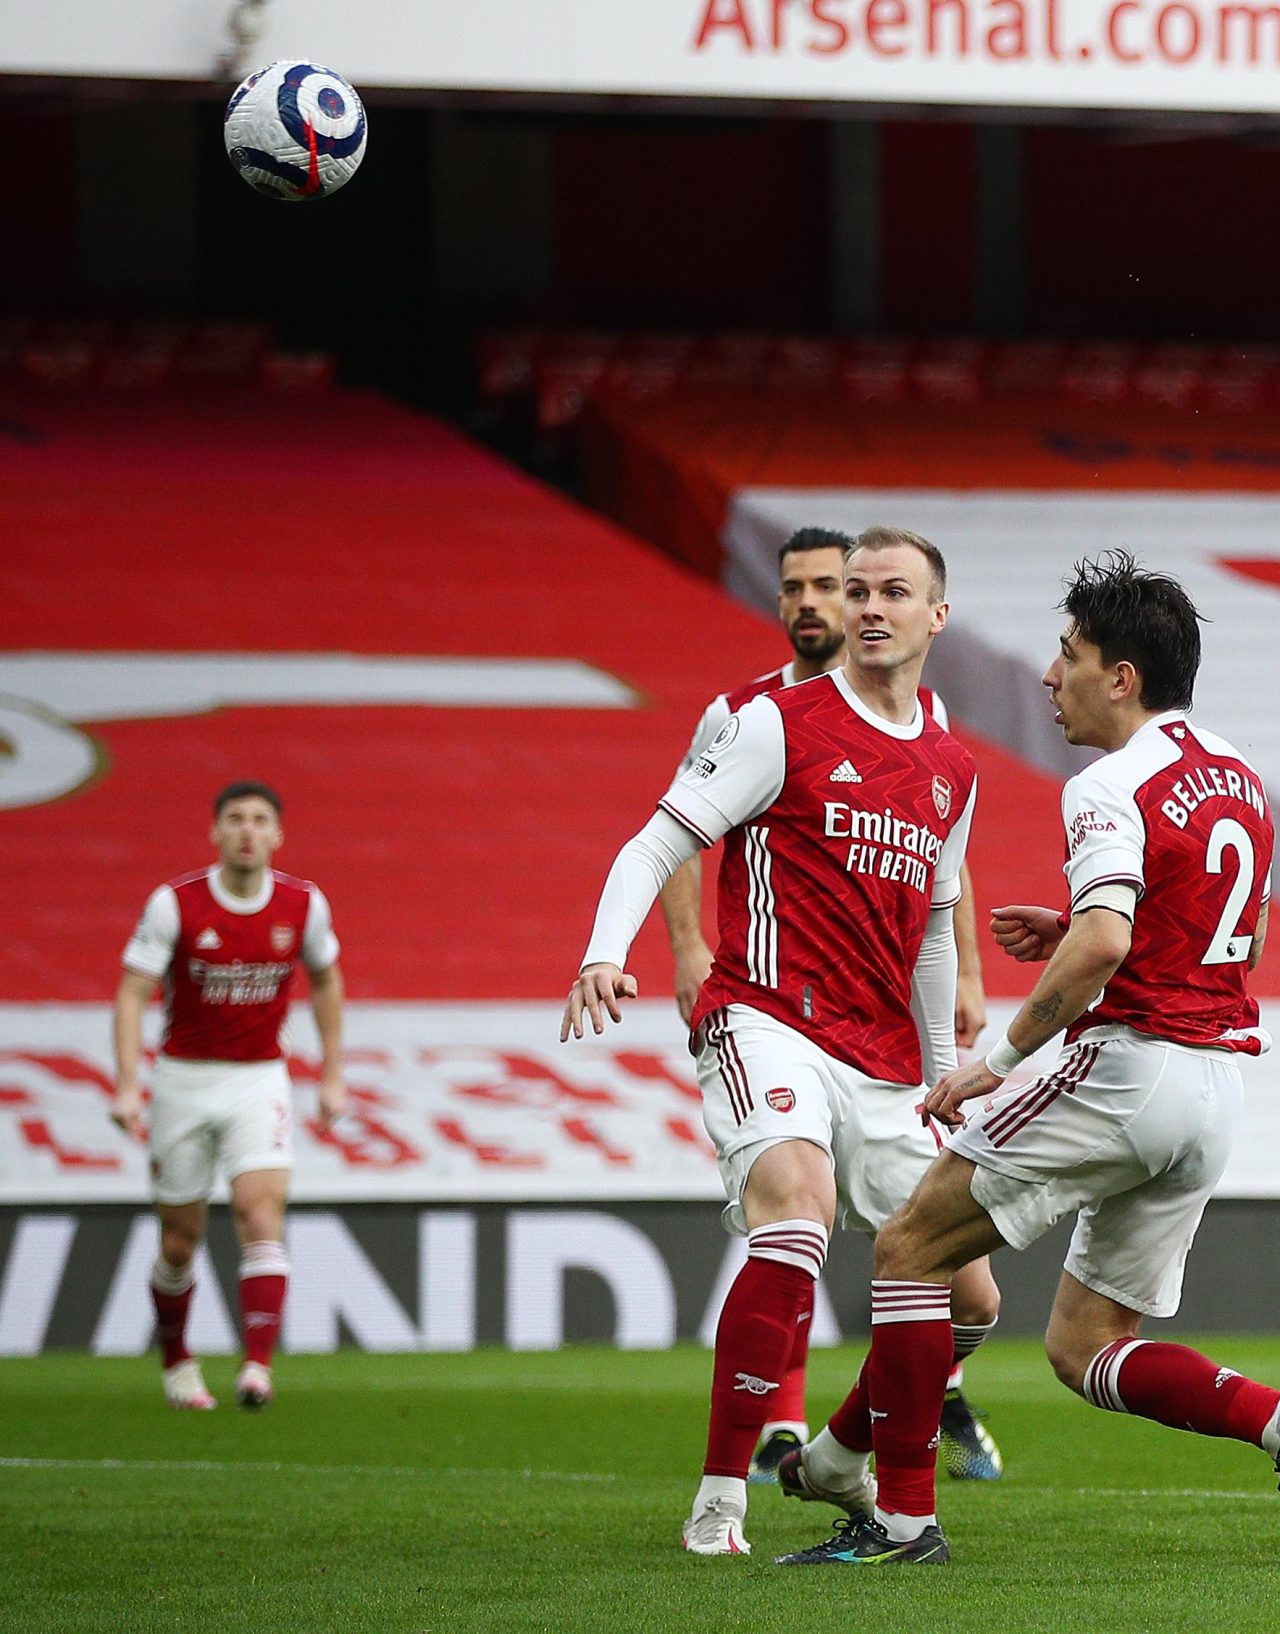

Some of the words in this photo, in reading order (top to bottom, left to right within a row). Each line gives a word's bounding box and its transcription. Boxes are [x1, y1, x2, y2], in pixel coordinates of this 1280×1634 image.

[1161, 767, 1265, 830] BELLERIN
[824, 801, 943, 866] Emirates
[846, 843, 878, 875] FLY
[1200, 817, 1255, 965] 2
[0, 1213, 842, 1356] ANDA
